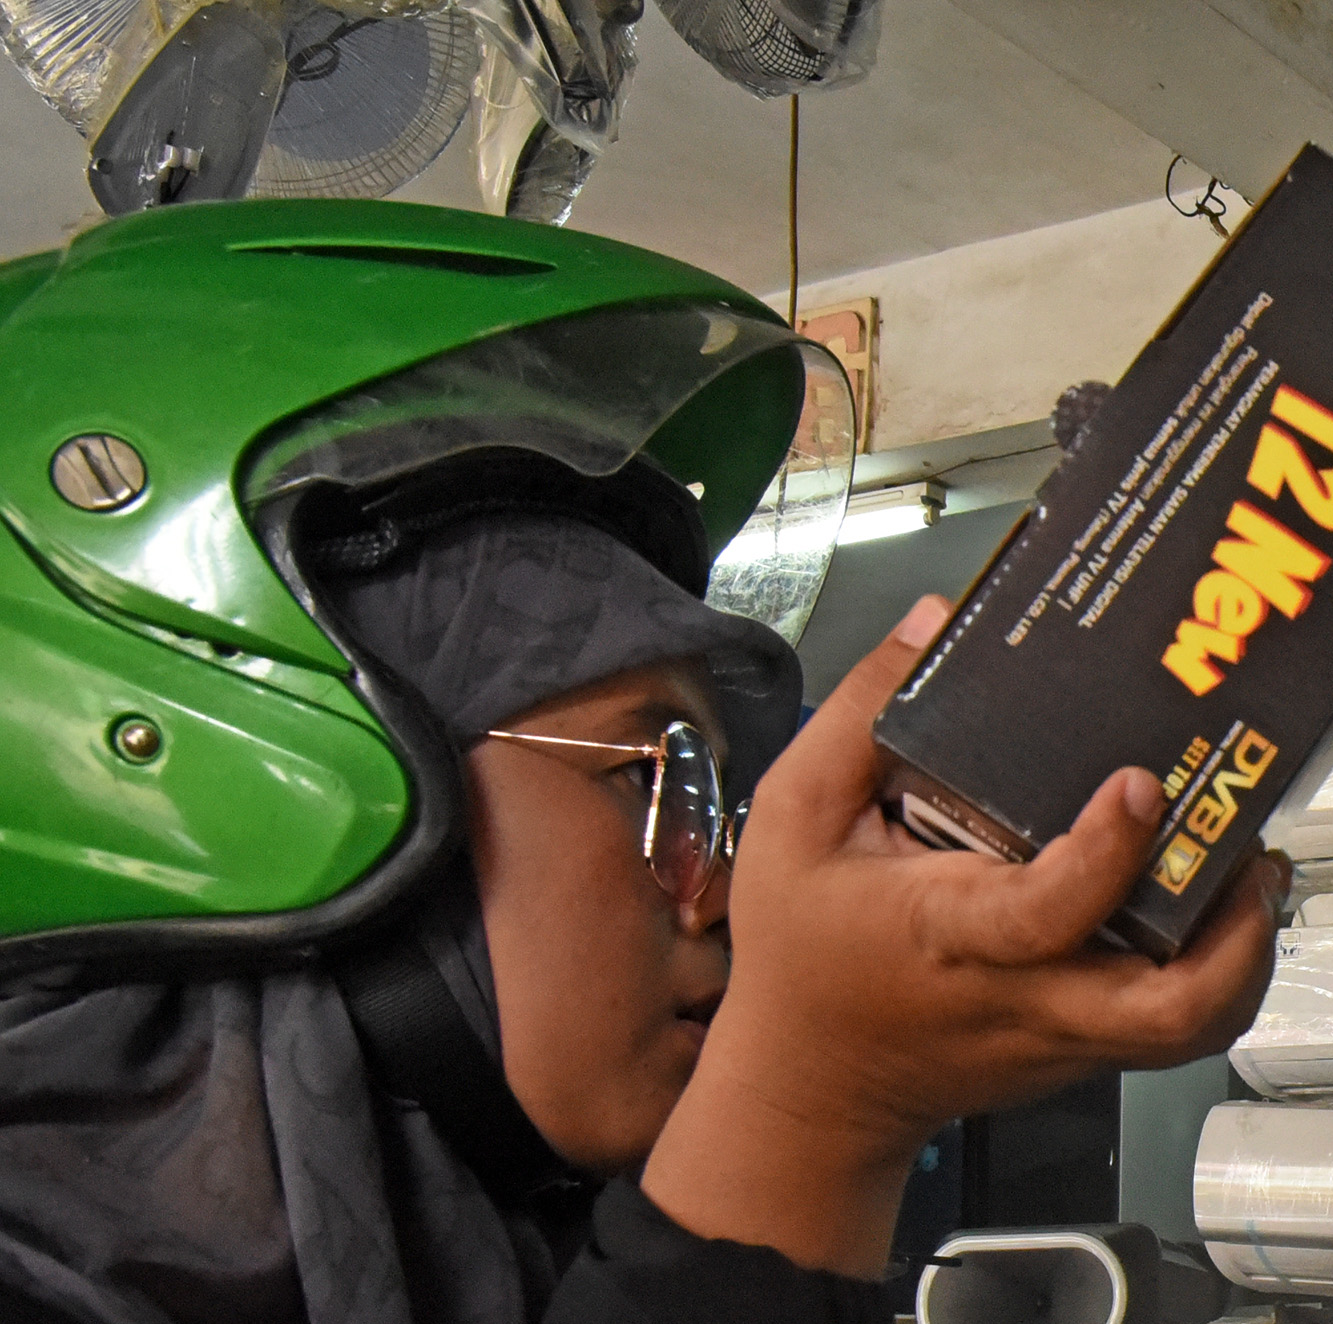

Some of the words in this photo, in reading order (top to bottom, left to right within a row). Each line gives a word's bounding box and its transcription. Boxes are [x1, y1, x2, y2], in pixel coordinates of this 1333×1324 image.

[1236, 289, 1273, 331] Dapat
[1193, 322, 1248, 389] digunakan
[1205, 342, 1259, 408] Perangkat
[1172, 382, 1204, 420] untuk
[1222, 358, 1280, 433] PERANGKAT
[1135, 414, 1204, 502] menggunakan
[1141, 414, 1180, 462] semua
[1180, 426, 1232, 490] PENERIMA
[1116, 454, 1151, 494] jenis
[1104, 489, 1128, 514] TV
[1147, 484, 1189, 535] SIARAN
[1084, 550, 1109, 576] TV
[1111, 529, 1156, 585] TELEVISI
[1063, 569, 1095, 605] UHF
[1076, 578, 1120, 632] DIGITAL
[1161, 500, 1333, 697] New
[1179, 734, 1212, 770] SET
[1157, 763, 1192, 801] TOP
[1182, 726, 1280, 847] DVB
[1149, 834, 1206, 895] T2
